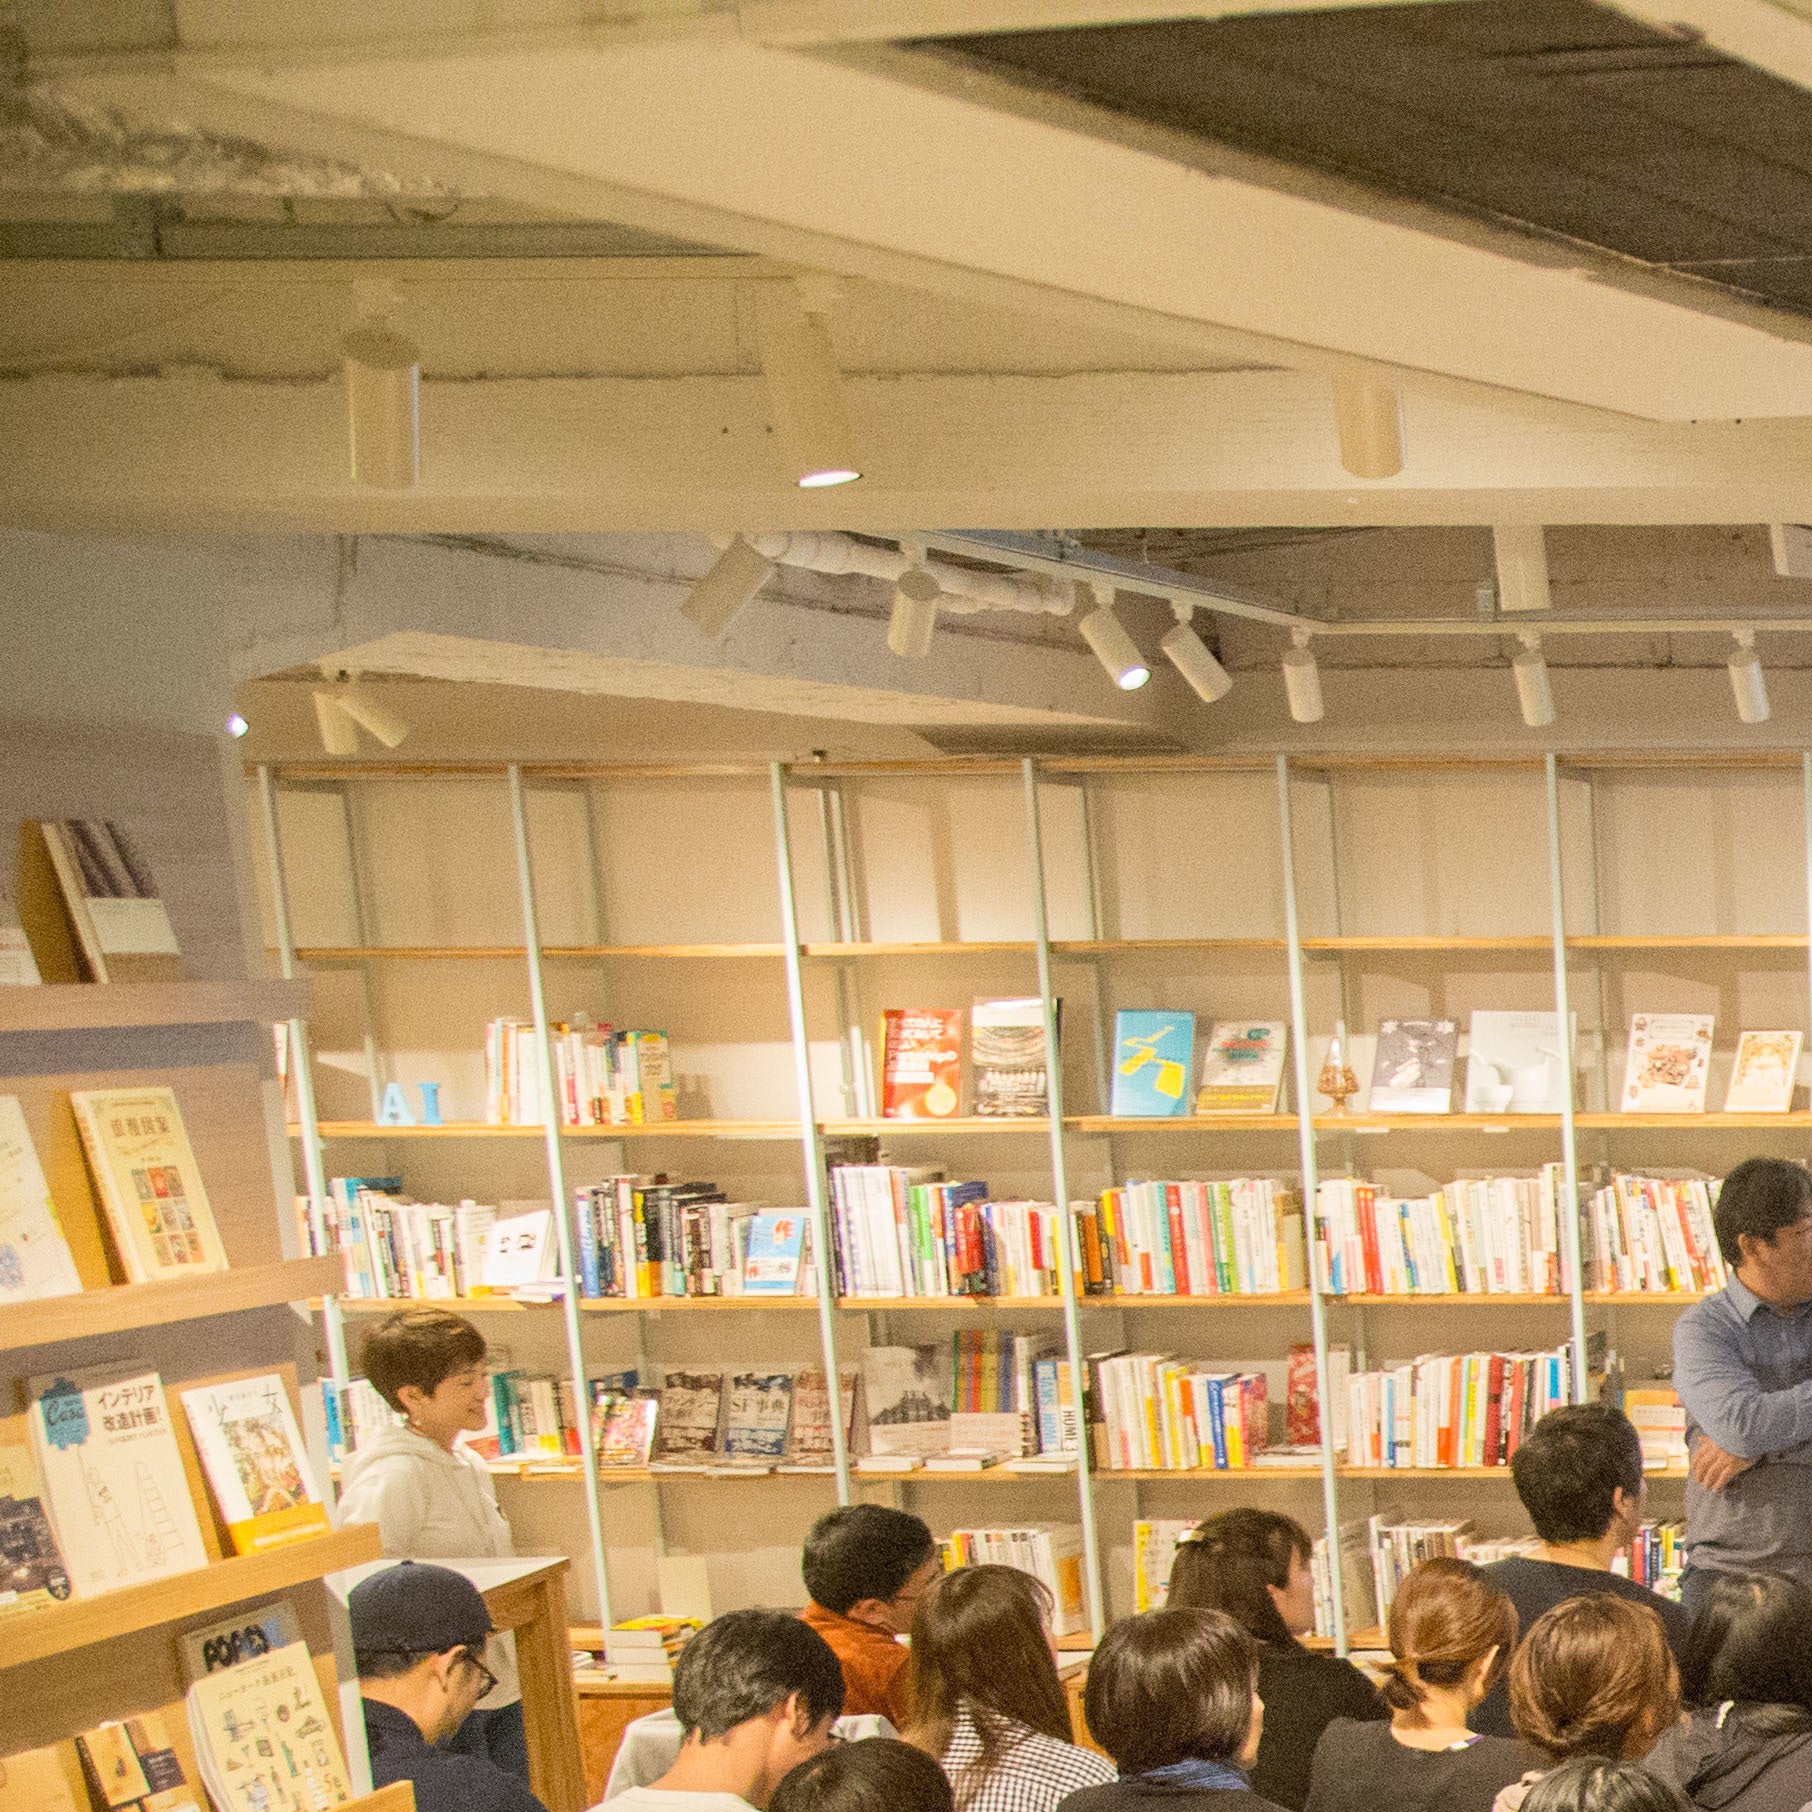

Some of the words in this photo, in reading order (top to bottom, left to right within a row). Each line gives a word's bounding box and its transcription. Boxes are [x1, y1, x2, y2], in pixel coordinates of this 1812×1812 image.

[98, 1384, 155, 1411] インテリア
